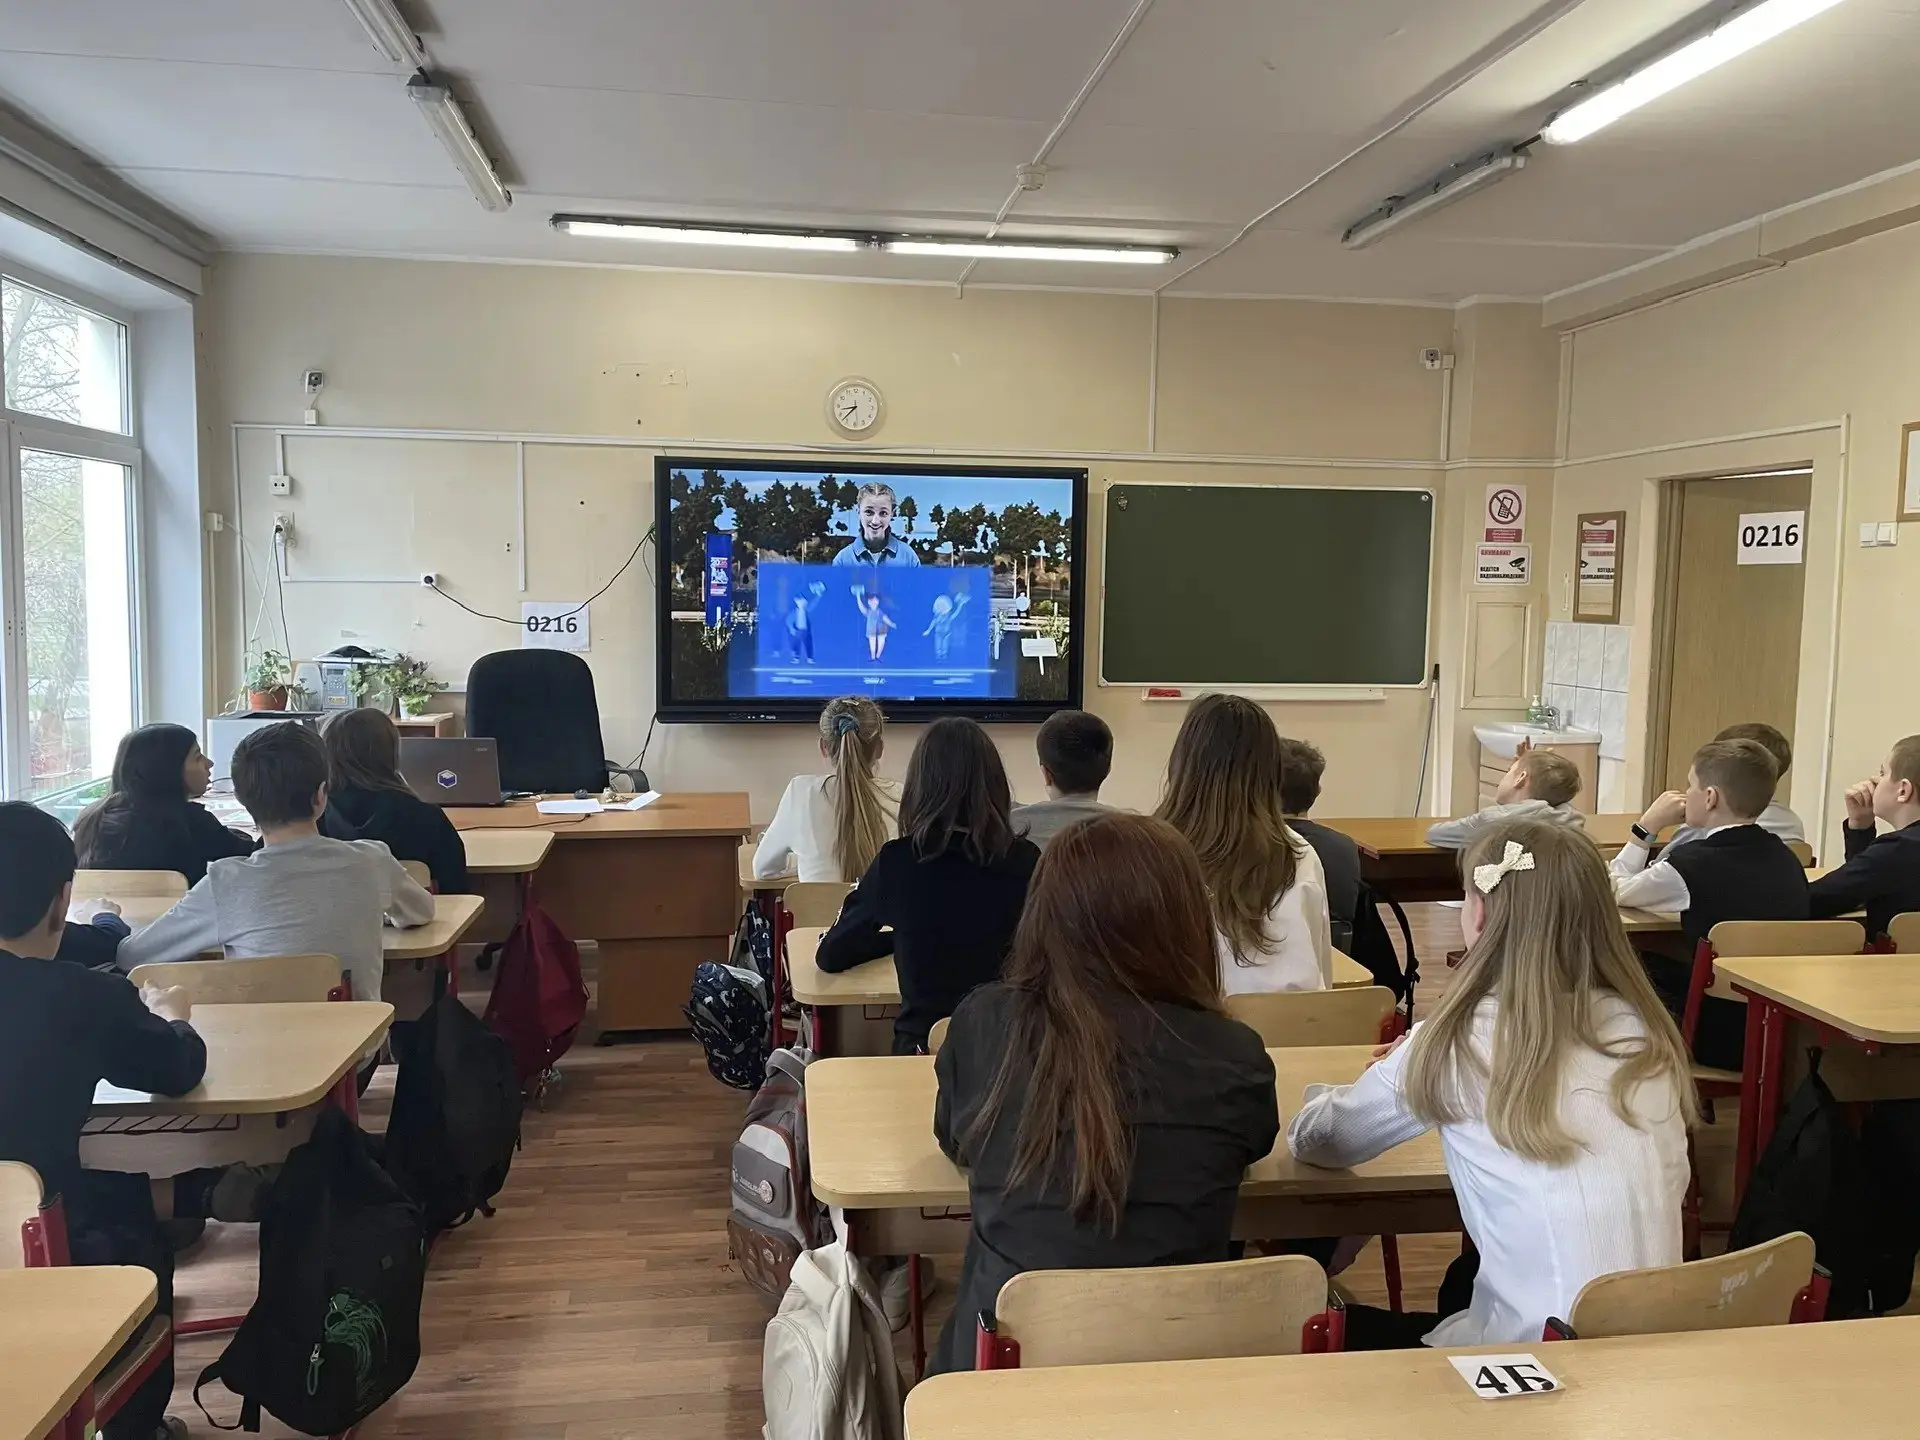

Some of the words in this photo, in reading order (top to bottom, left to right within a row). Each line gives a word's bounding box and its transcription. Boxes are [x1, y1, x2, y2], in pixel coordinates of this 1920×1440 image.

[1742, 524, 1799, 547] 0216
[526, 615, 578, 633] 0216
[1475, 1364, 1555, 1394] 4Б
